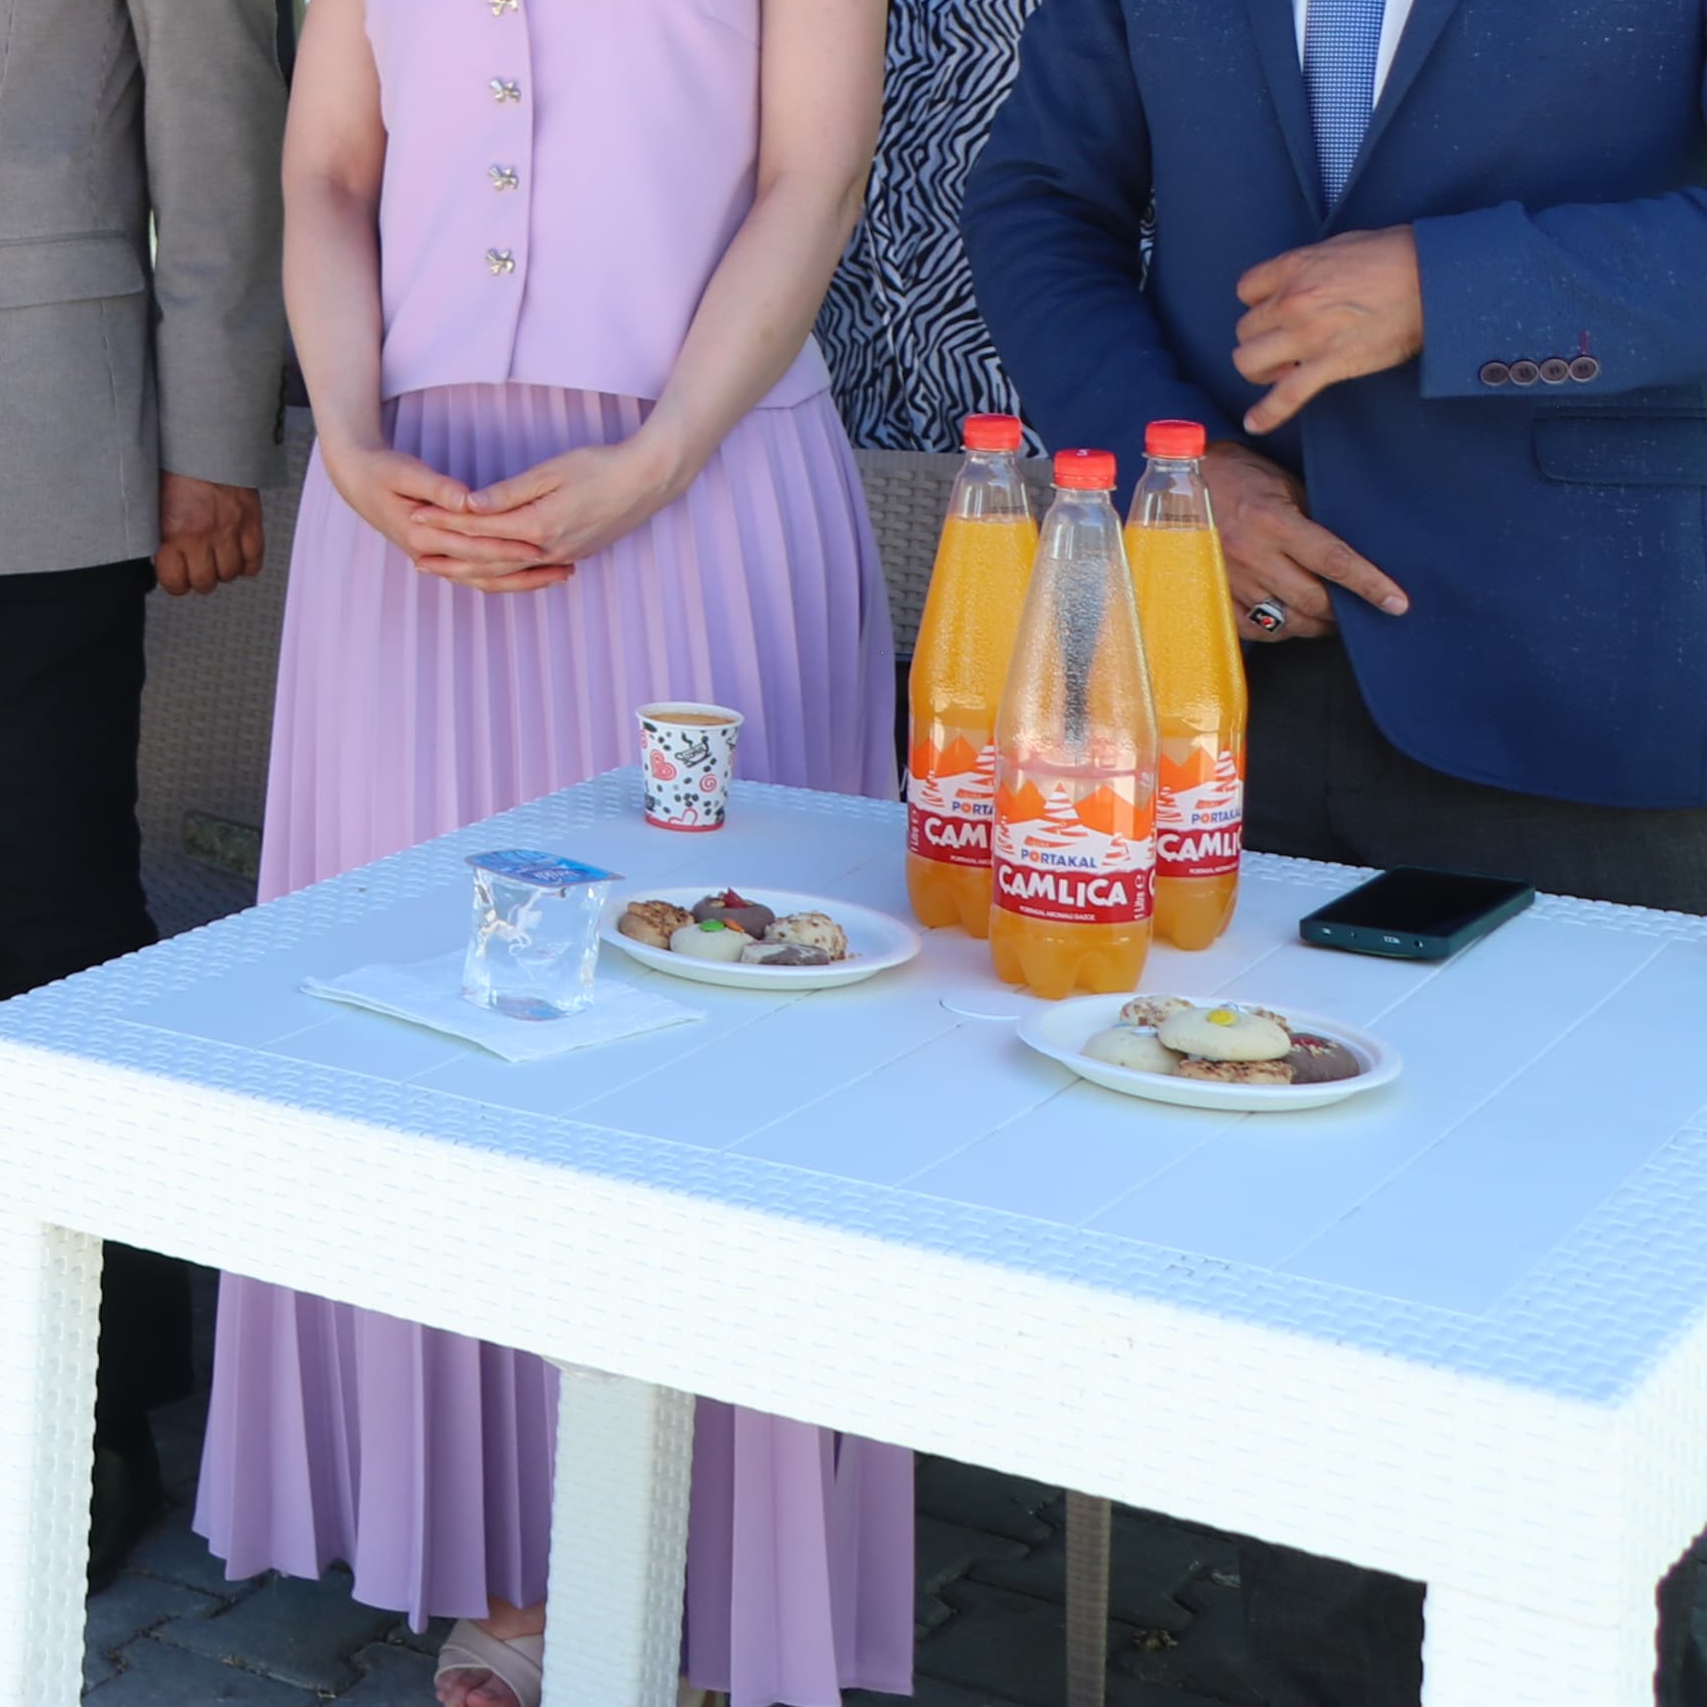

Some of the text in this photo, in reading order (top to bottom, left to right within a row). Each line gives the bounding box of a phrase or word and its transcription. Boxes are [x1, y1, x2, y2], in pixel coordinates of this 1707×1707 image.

[951, 800, 993, 815] PORT
[1156, 824, 1242, 862] ÇAMLI
[1021, 848, 1097, 869] PORTAKAL
